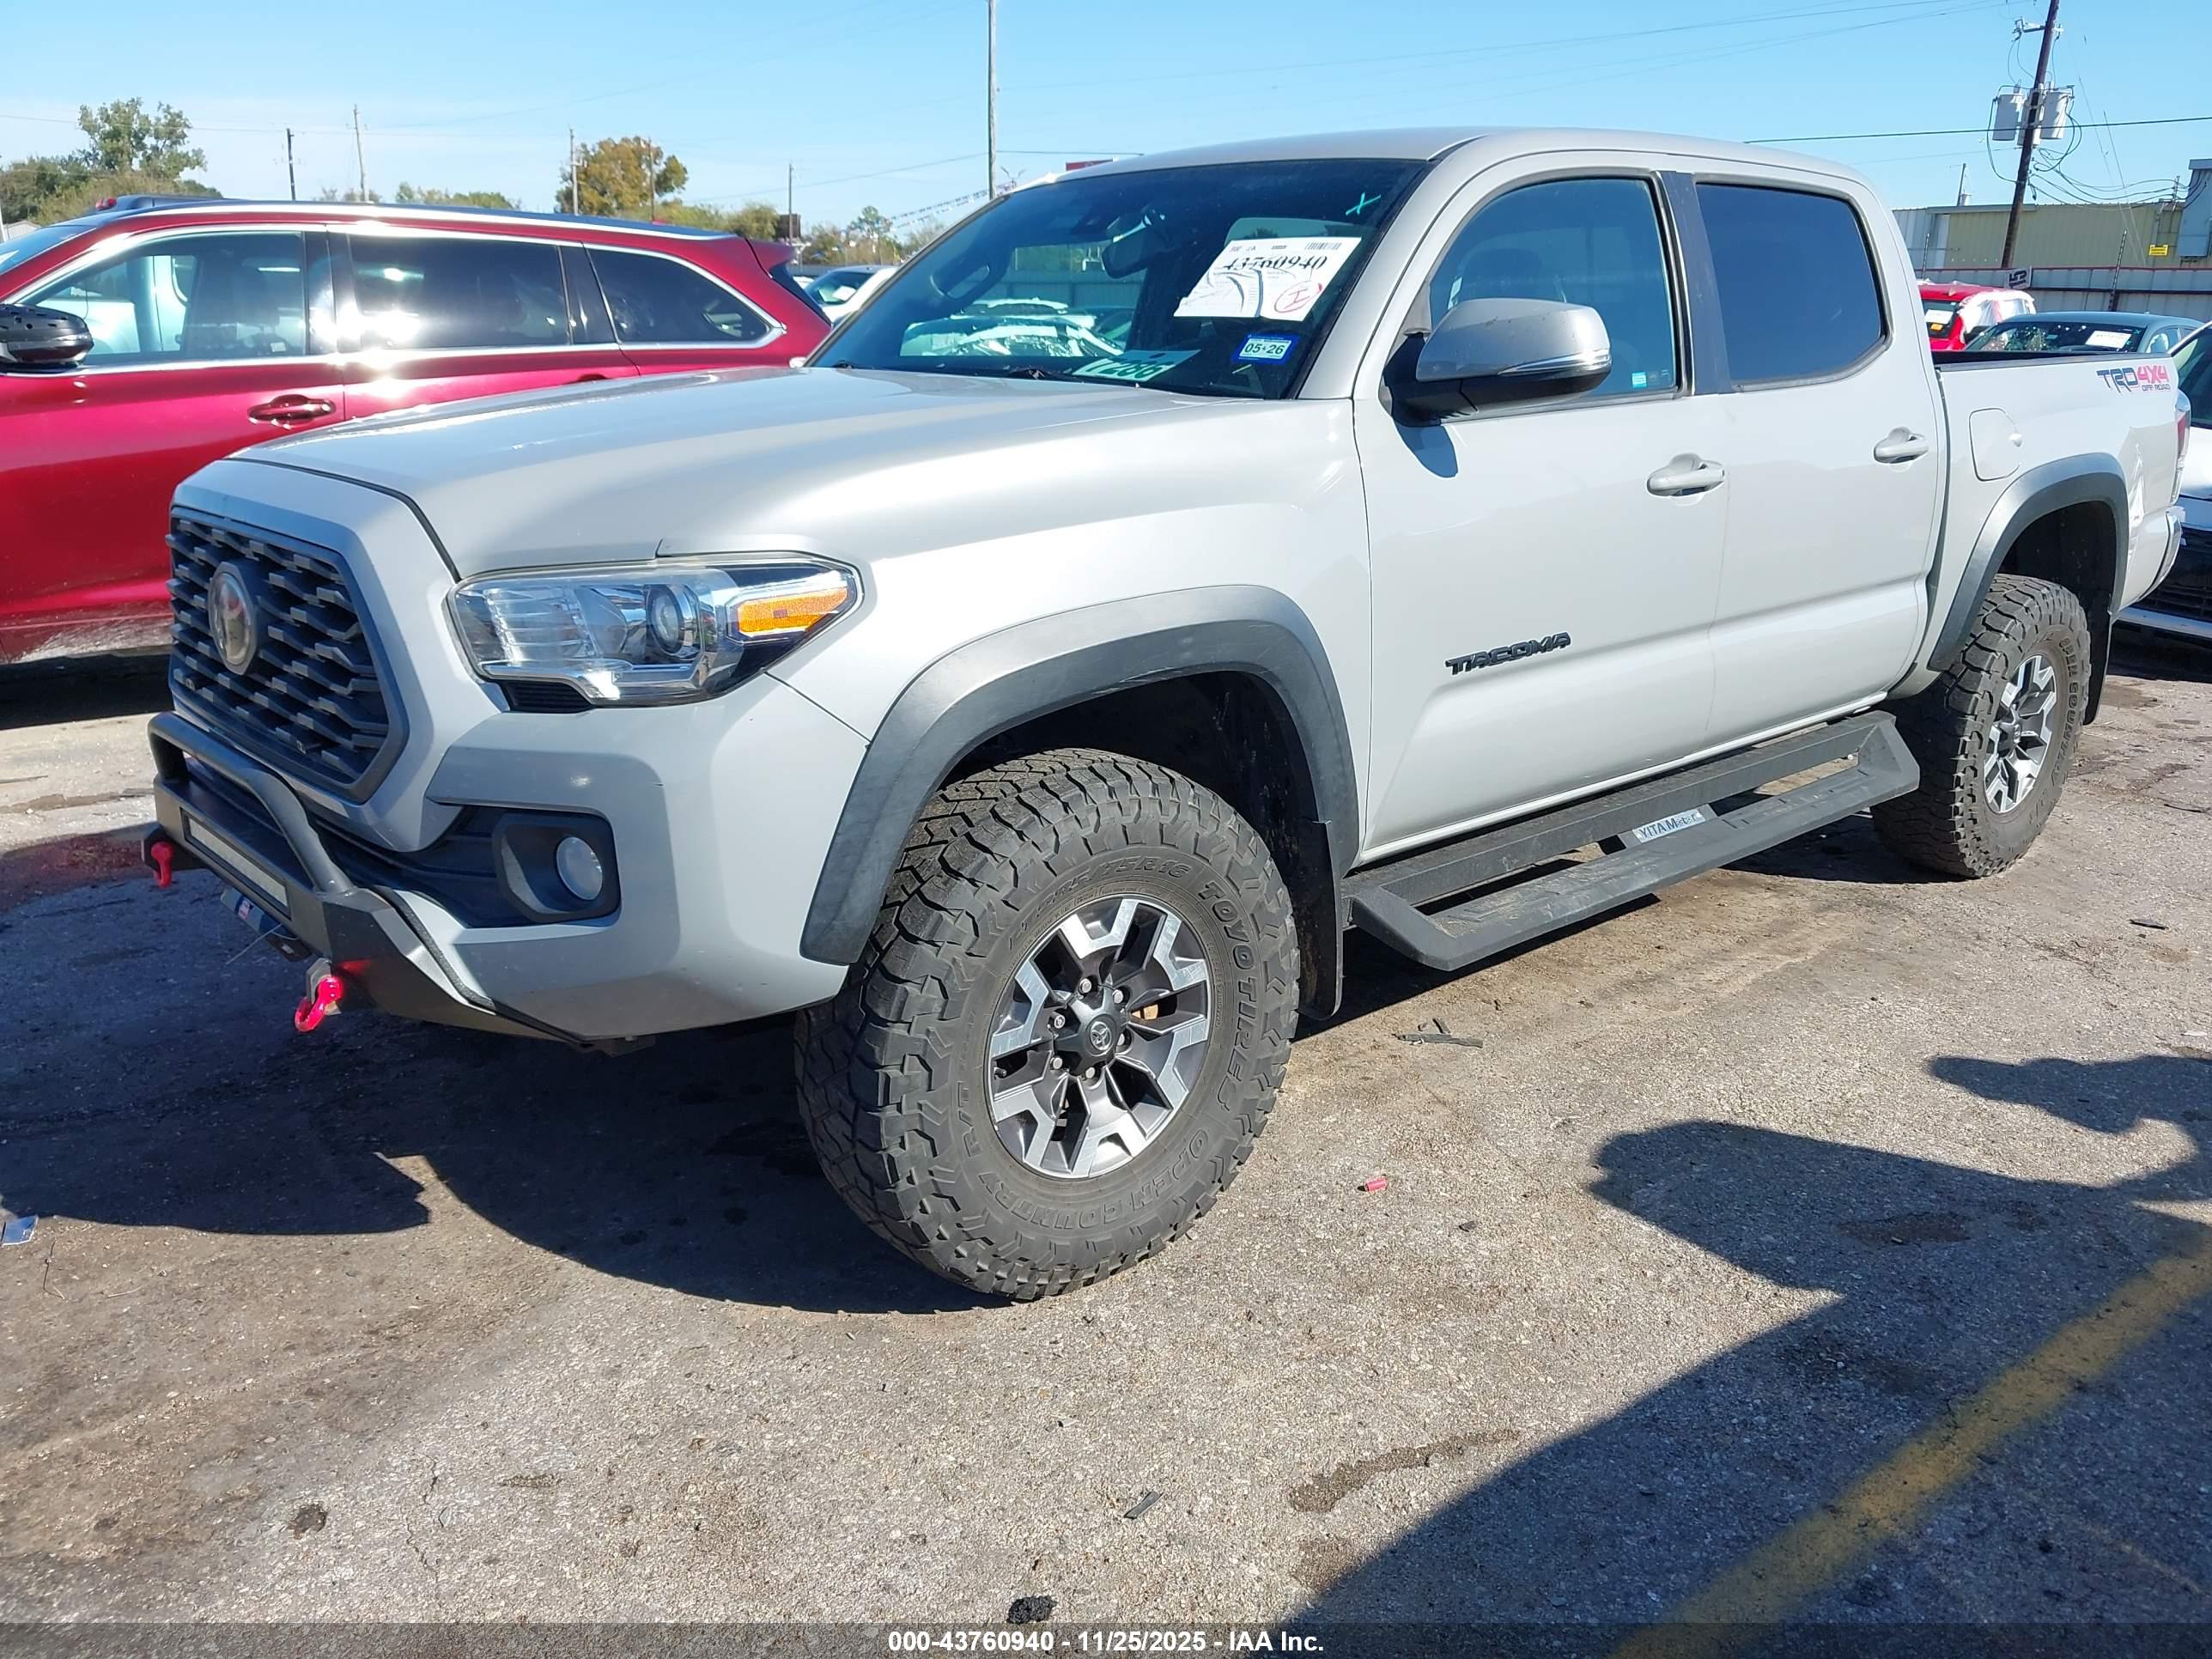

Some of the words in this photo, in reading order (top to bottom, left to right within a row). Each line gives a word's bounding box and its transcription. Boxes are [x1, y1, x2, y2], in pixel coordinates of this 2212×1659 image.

[2096, 367, 2138, 393] TRD
[1444, 632, 1571, 676] TACOMA
[1198, 880, 1257, 970] TOYO
[1216, 975, 1258, 1112] TIRES
[978, 1171, 1122, 1230] COUNTRY
[1130, 1129, 1209, 1212] OPEN
